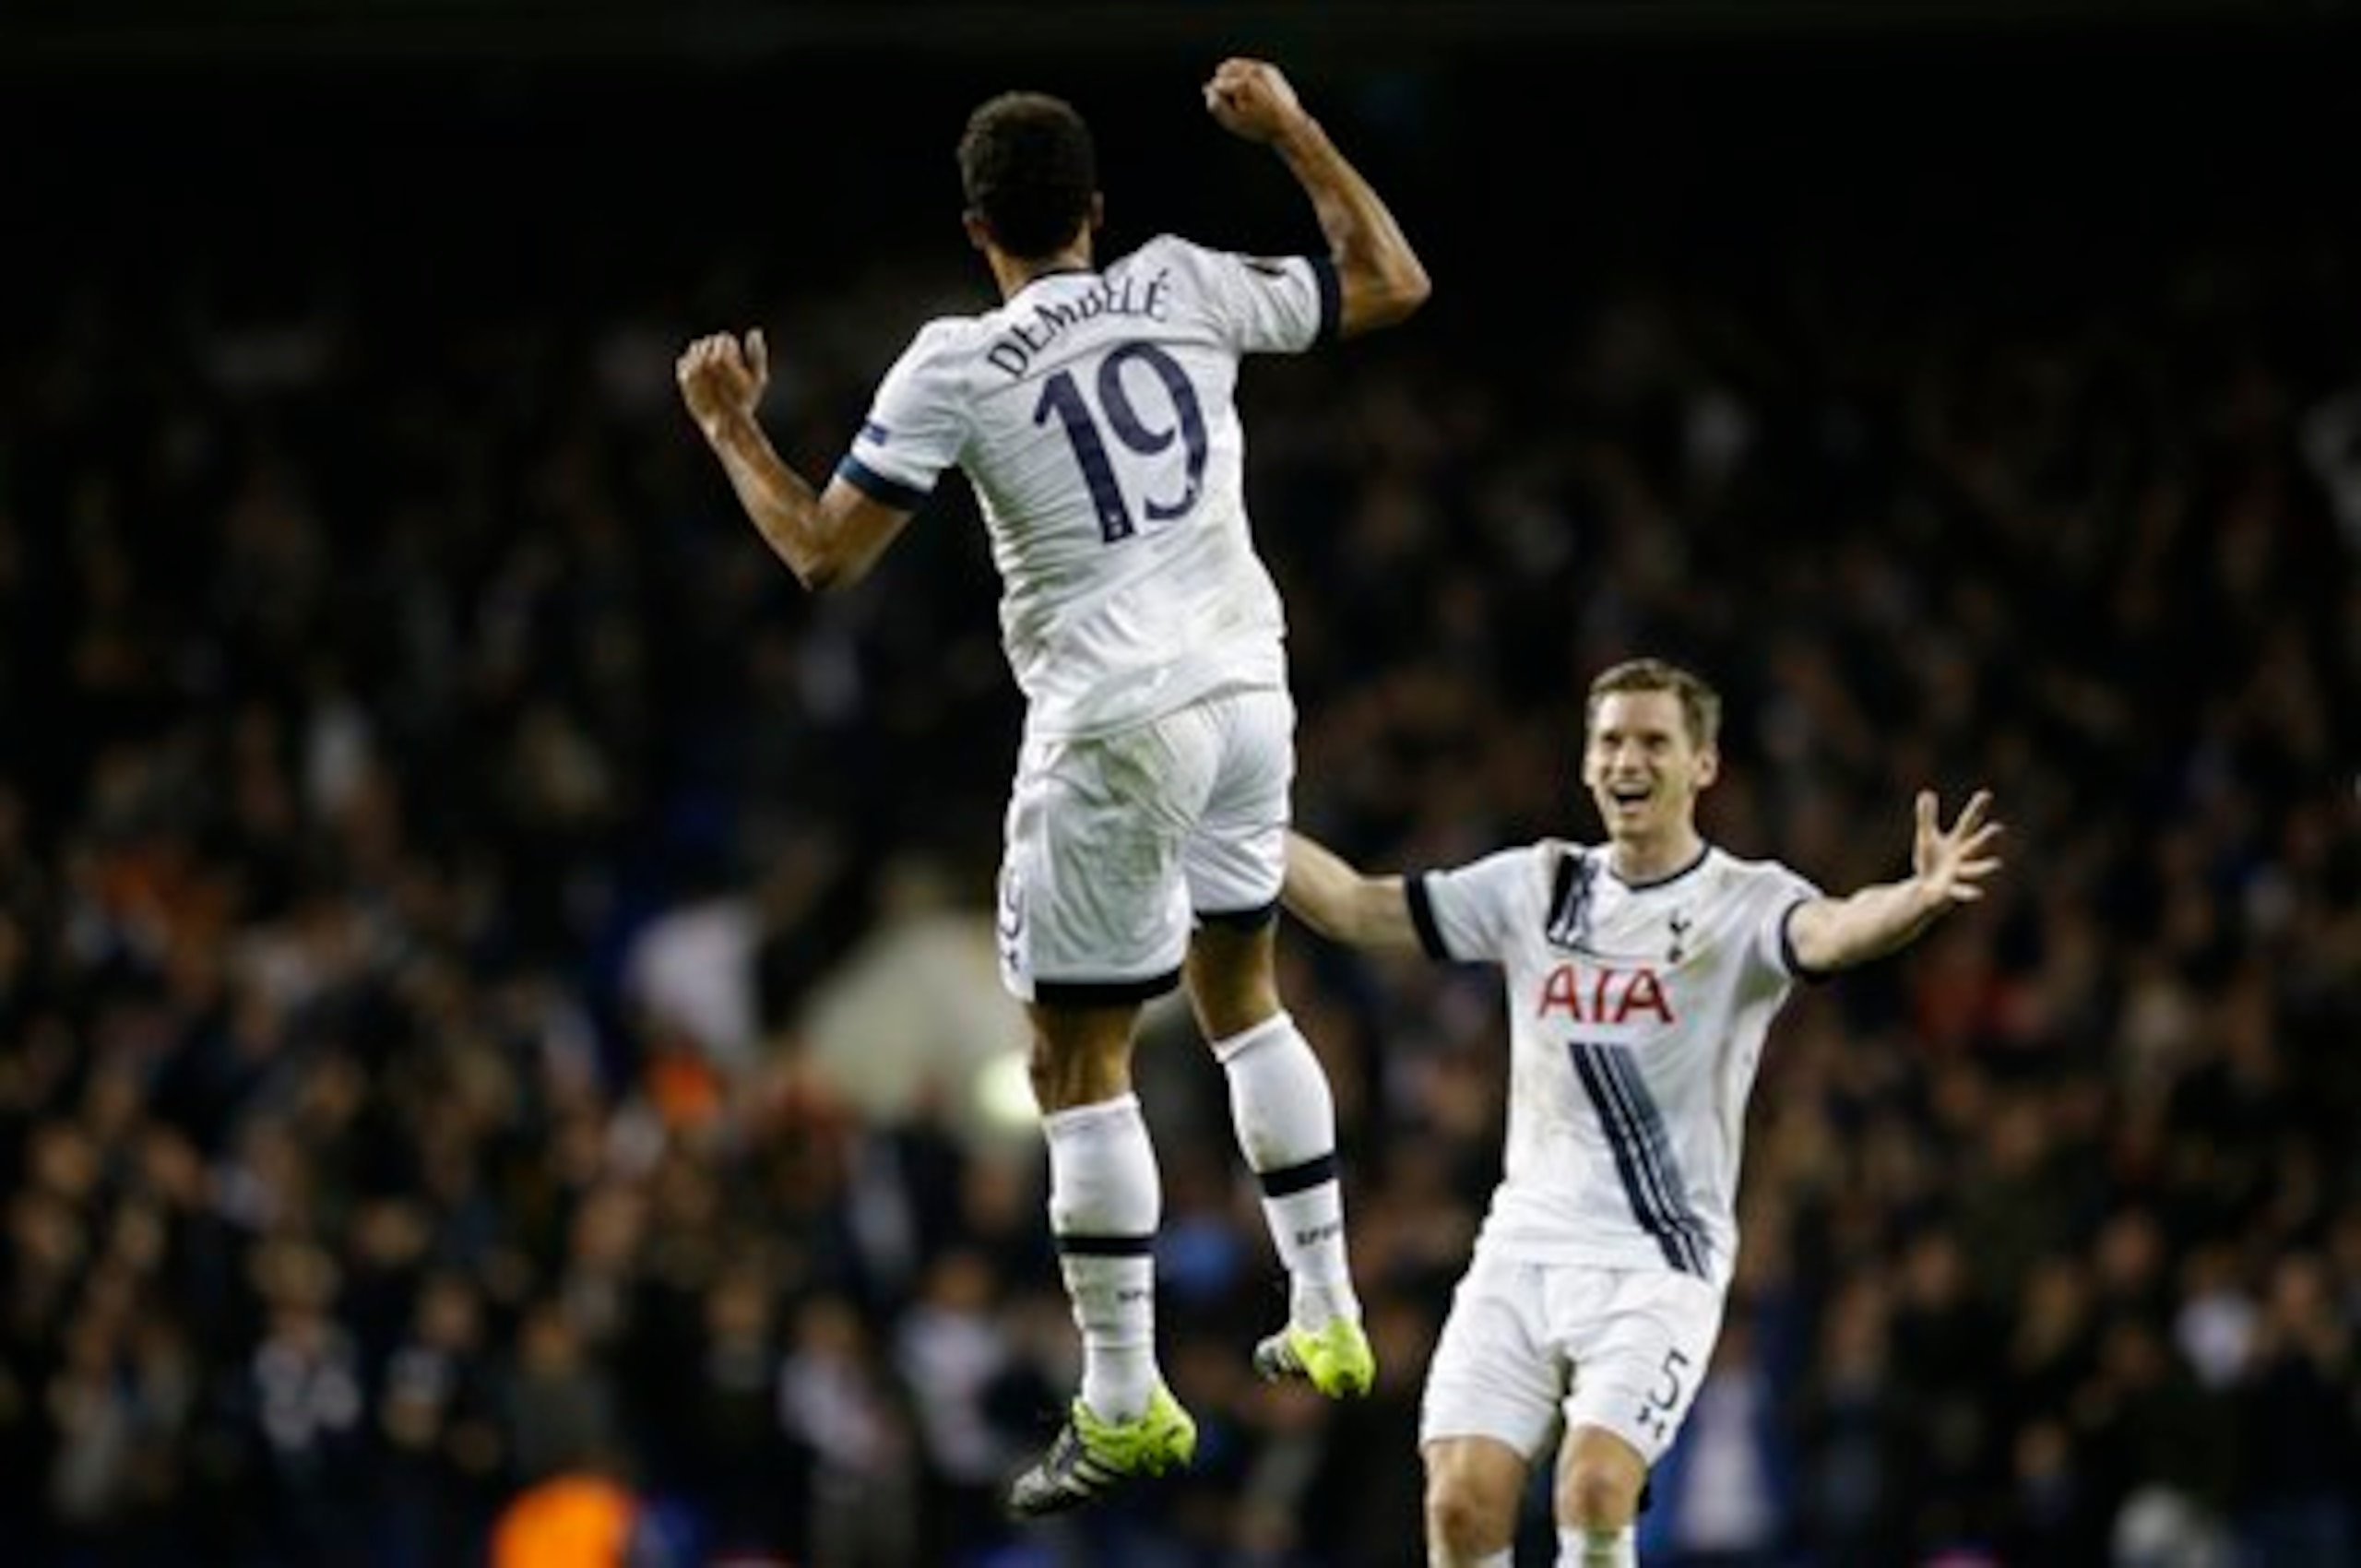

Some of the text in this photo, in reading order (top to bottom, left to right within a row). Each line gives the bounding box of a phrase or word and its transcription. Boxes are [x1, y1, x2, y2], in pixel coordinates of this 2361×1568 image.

[1033, 341, 1207, 543] 19
[1538, 963, 1674, 1023] AIA
[1648, 1348, 1689, 1410] 5
